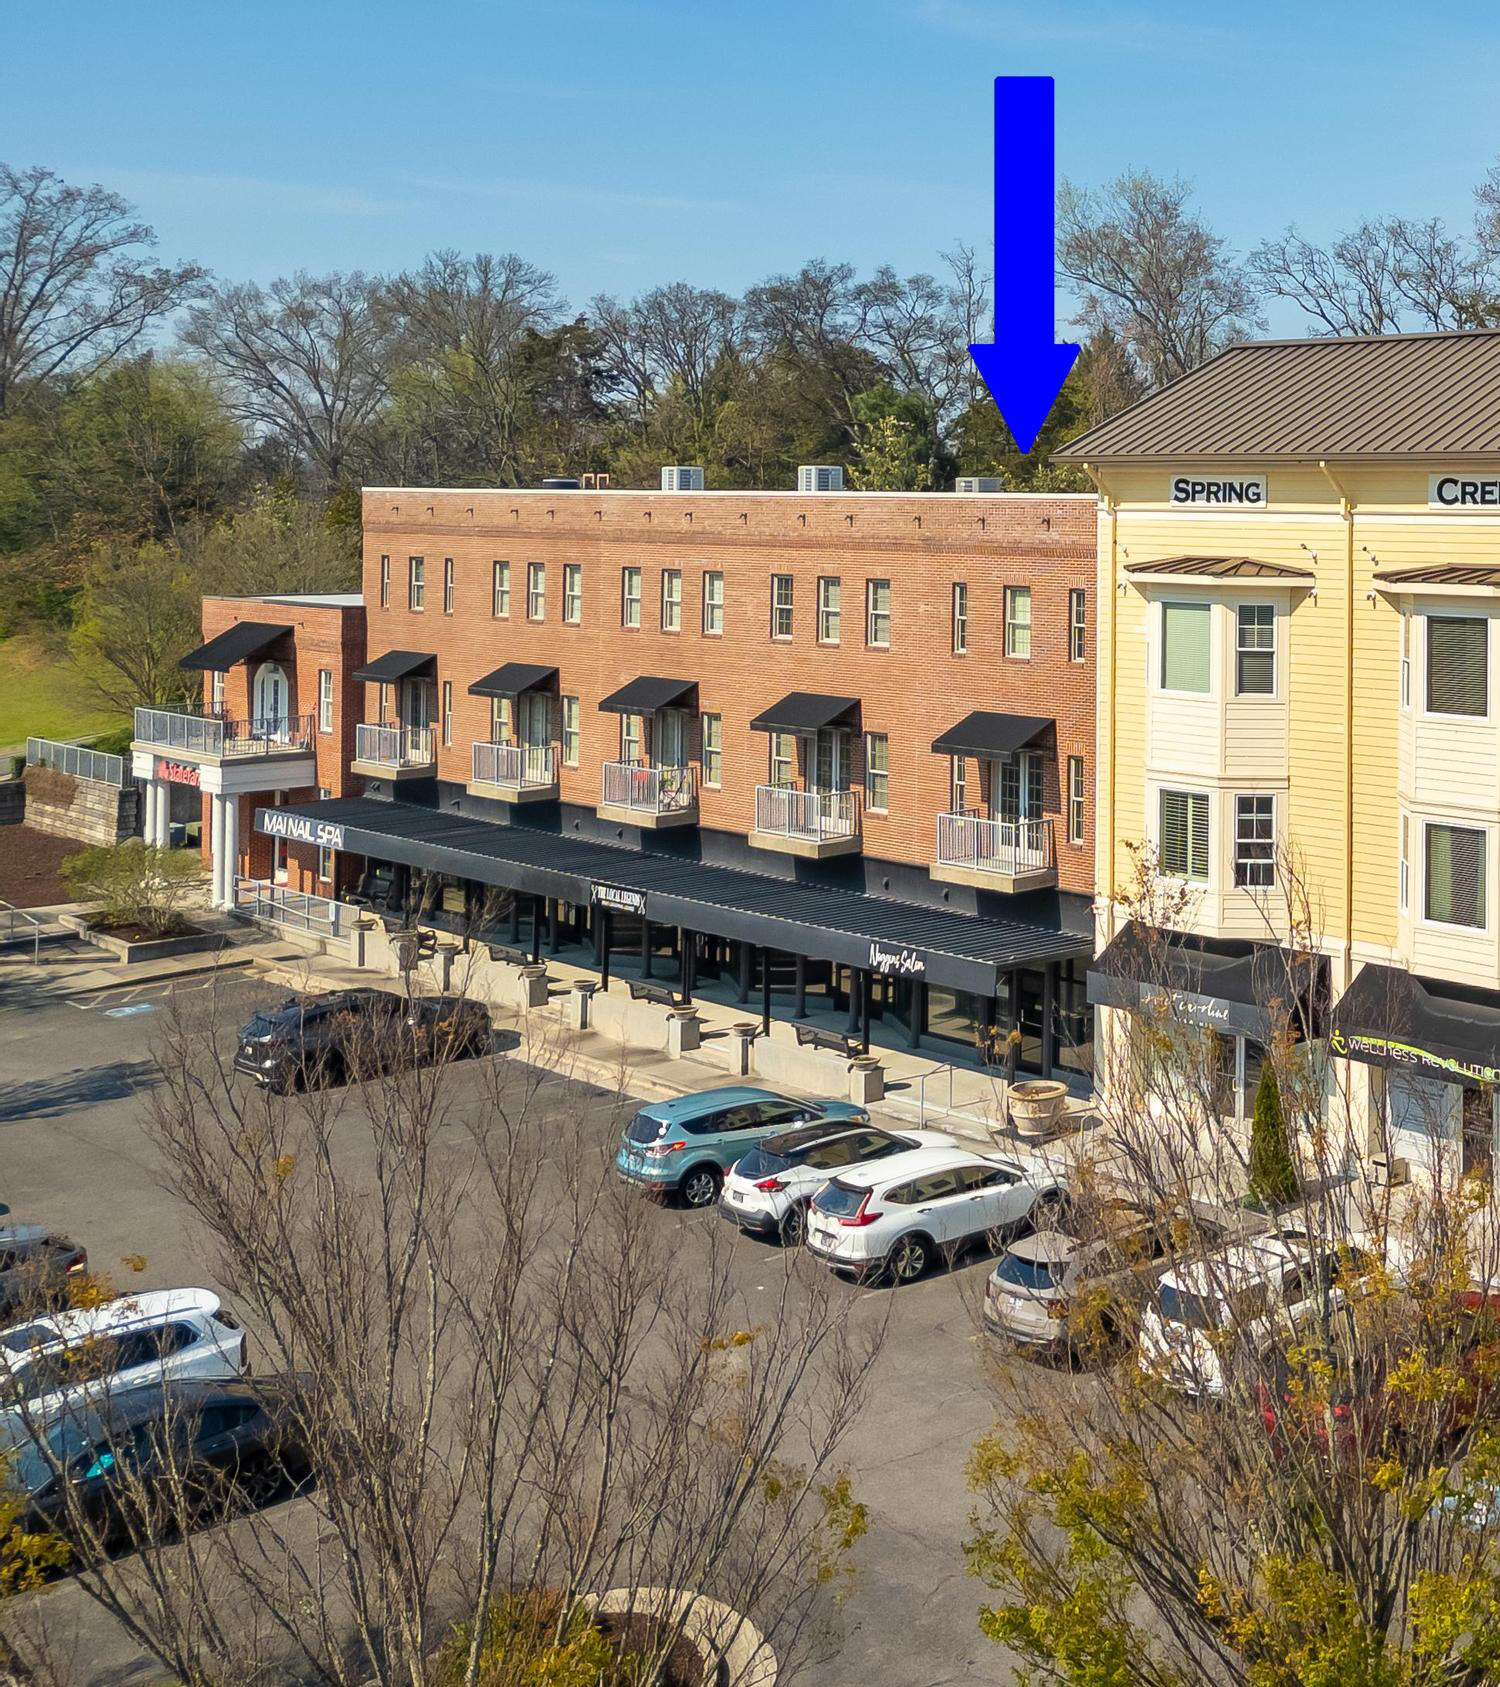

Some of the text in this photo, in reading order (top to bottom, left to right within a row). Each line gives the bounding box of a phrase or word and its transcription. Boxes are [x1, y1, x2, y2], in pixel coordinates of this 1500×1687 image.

[263, 812, 342, 847] MAI NAIL SPA
[900, 949, 926, 973] Salon
